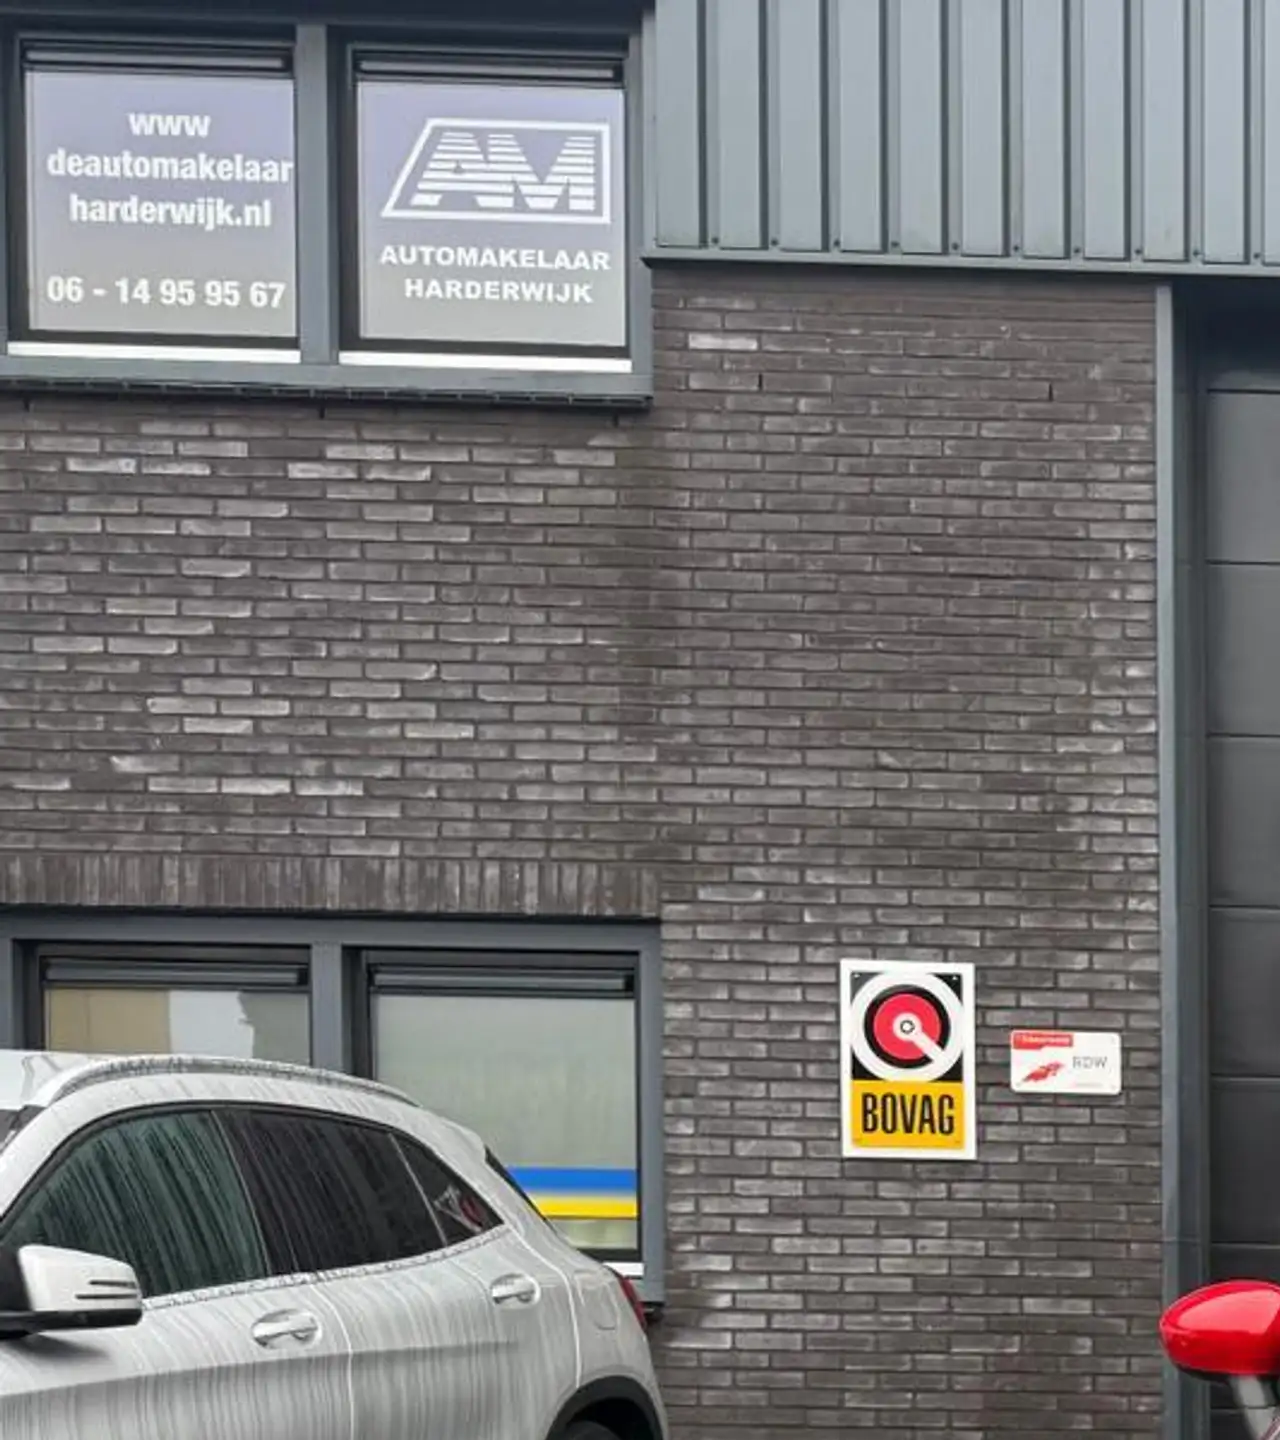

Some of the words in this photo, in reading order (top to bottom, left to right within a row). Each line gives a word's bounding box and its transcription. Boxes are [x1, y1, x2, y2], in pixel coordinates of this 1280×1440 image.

[128, 113, 212, 138] www
[47, 148, 294, 183] deautomakelaar
[69, 193, 273, 231] harderwijk.nl
[379, 245, 611, 271] AUTOMAKELAAR
[47, 275, 84, 304] 06
[115, 279, 151, 305] 14
[159, 280, 197, 306] 95
[205, 280, 242, 307] 95
[249, 281, 287, 309] 67
[404, 278, 594, 304] HARDERWIJK
[861, 1093, 955, 1135] BOVAG
